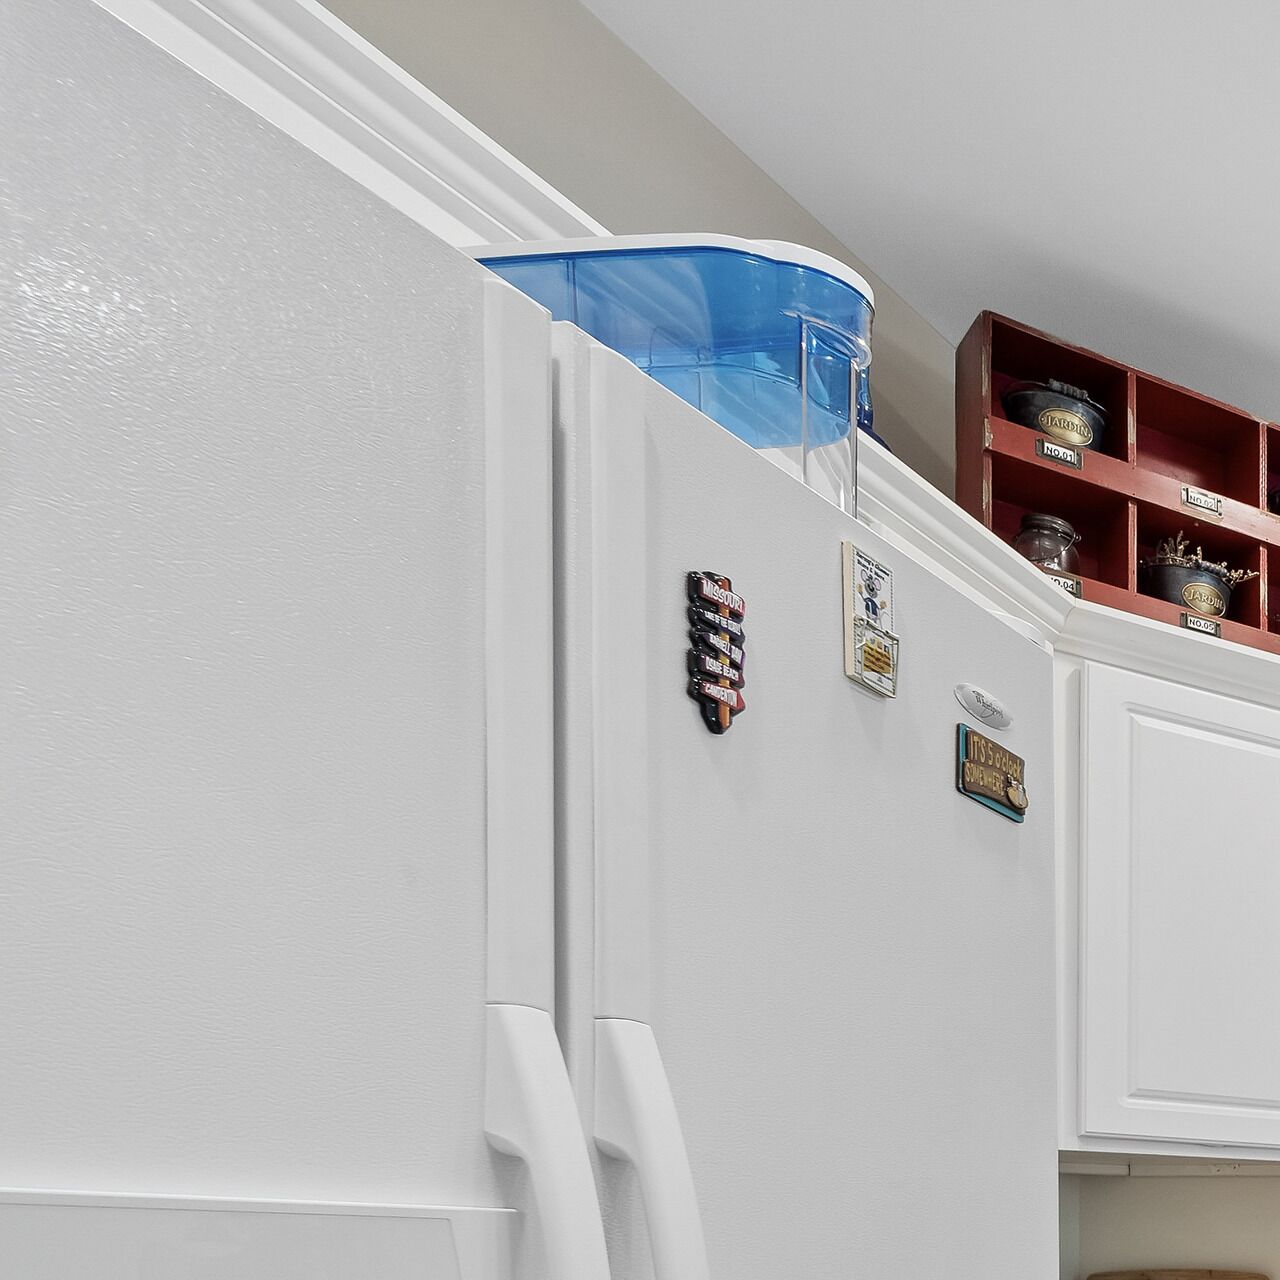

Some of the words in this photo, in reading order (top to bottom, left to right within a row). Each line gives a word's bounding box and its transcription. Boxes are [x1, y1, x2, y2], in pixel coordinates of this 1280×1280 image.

[1046, 415, 1089, 436] JARDIN
[1045, 445, 1074, 463] NO.01
[1189, 495, 1215, 510] NO.02
[1050, 576, 1074, 593] O.04
[702, 580, 743, 612] MISSOURI
[1188, 589, 1224, 609] JARDIN
[1188, 618, 1214, 632] NO.05
[987, 743, 993, 766] 5
[995, 751, 1022, 781] o'clock
